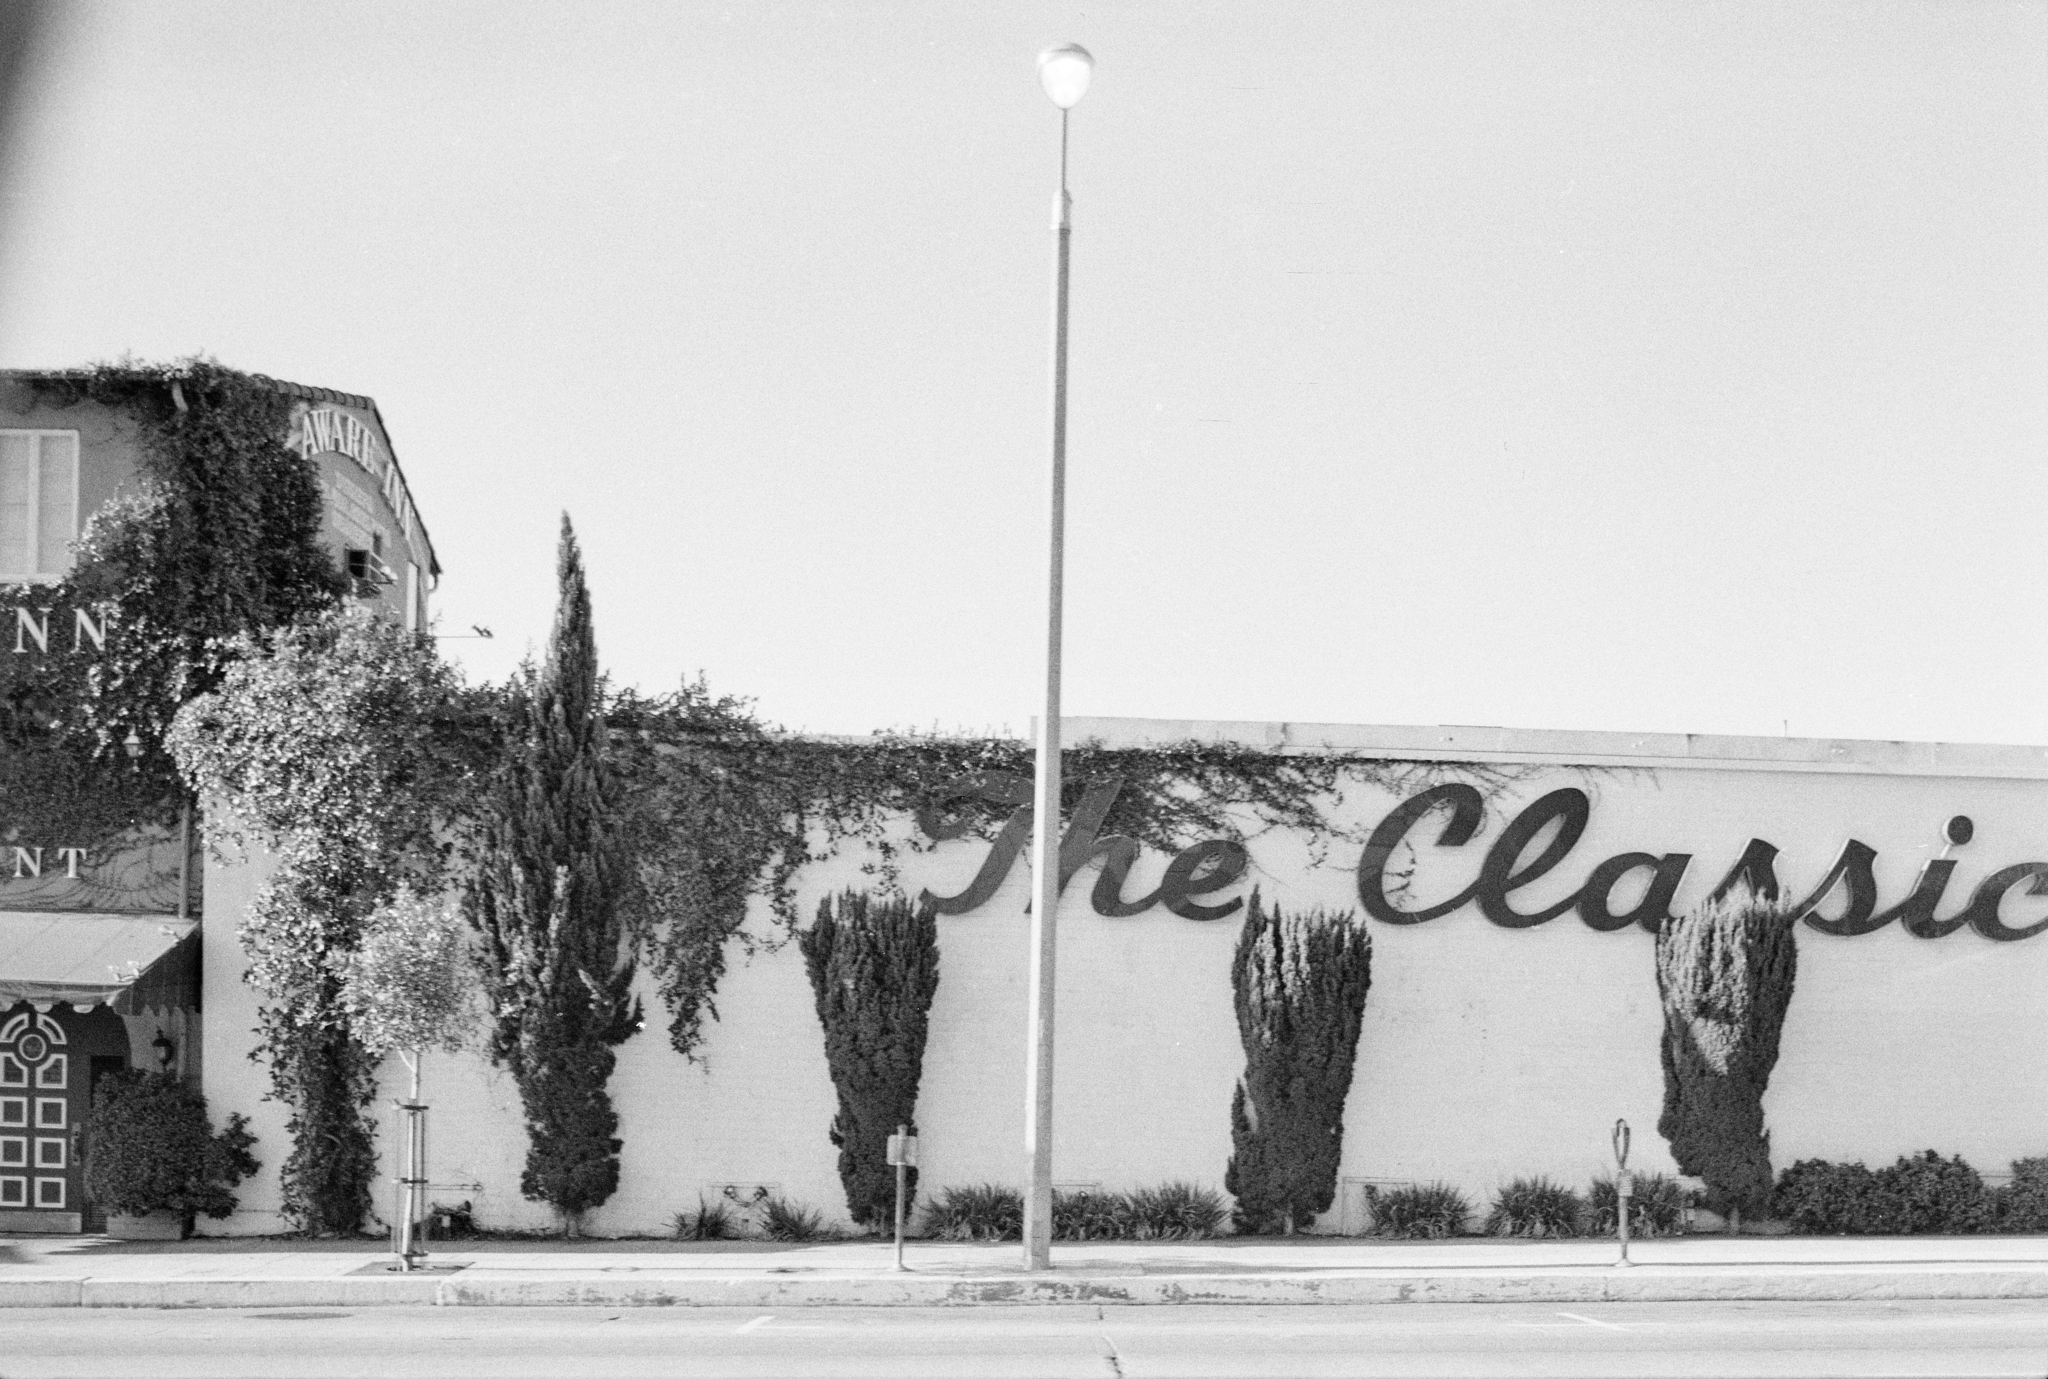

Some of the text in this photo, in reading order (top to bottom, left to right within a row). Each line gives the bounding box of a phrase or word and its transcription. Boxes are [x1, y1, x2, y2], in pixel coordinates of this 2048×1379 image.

[301, 411, 383, 477] AWARE
[916, 770, 2048, 941] The Classic
